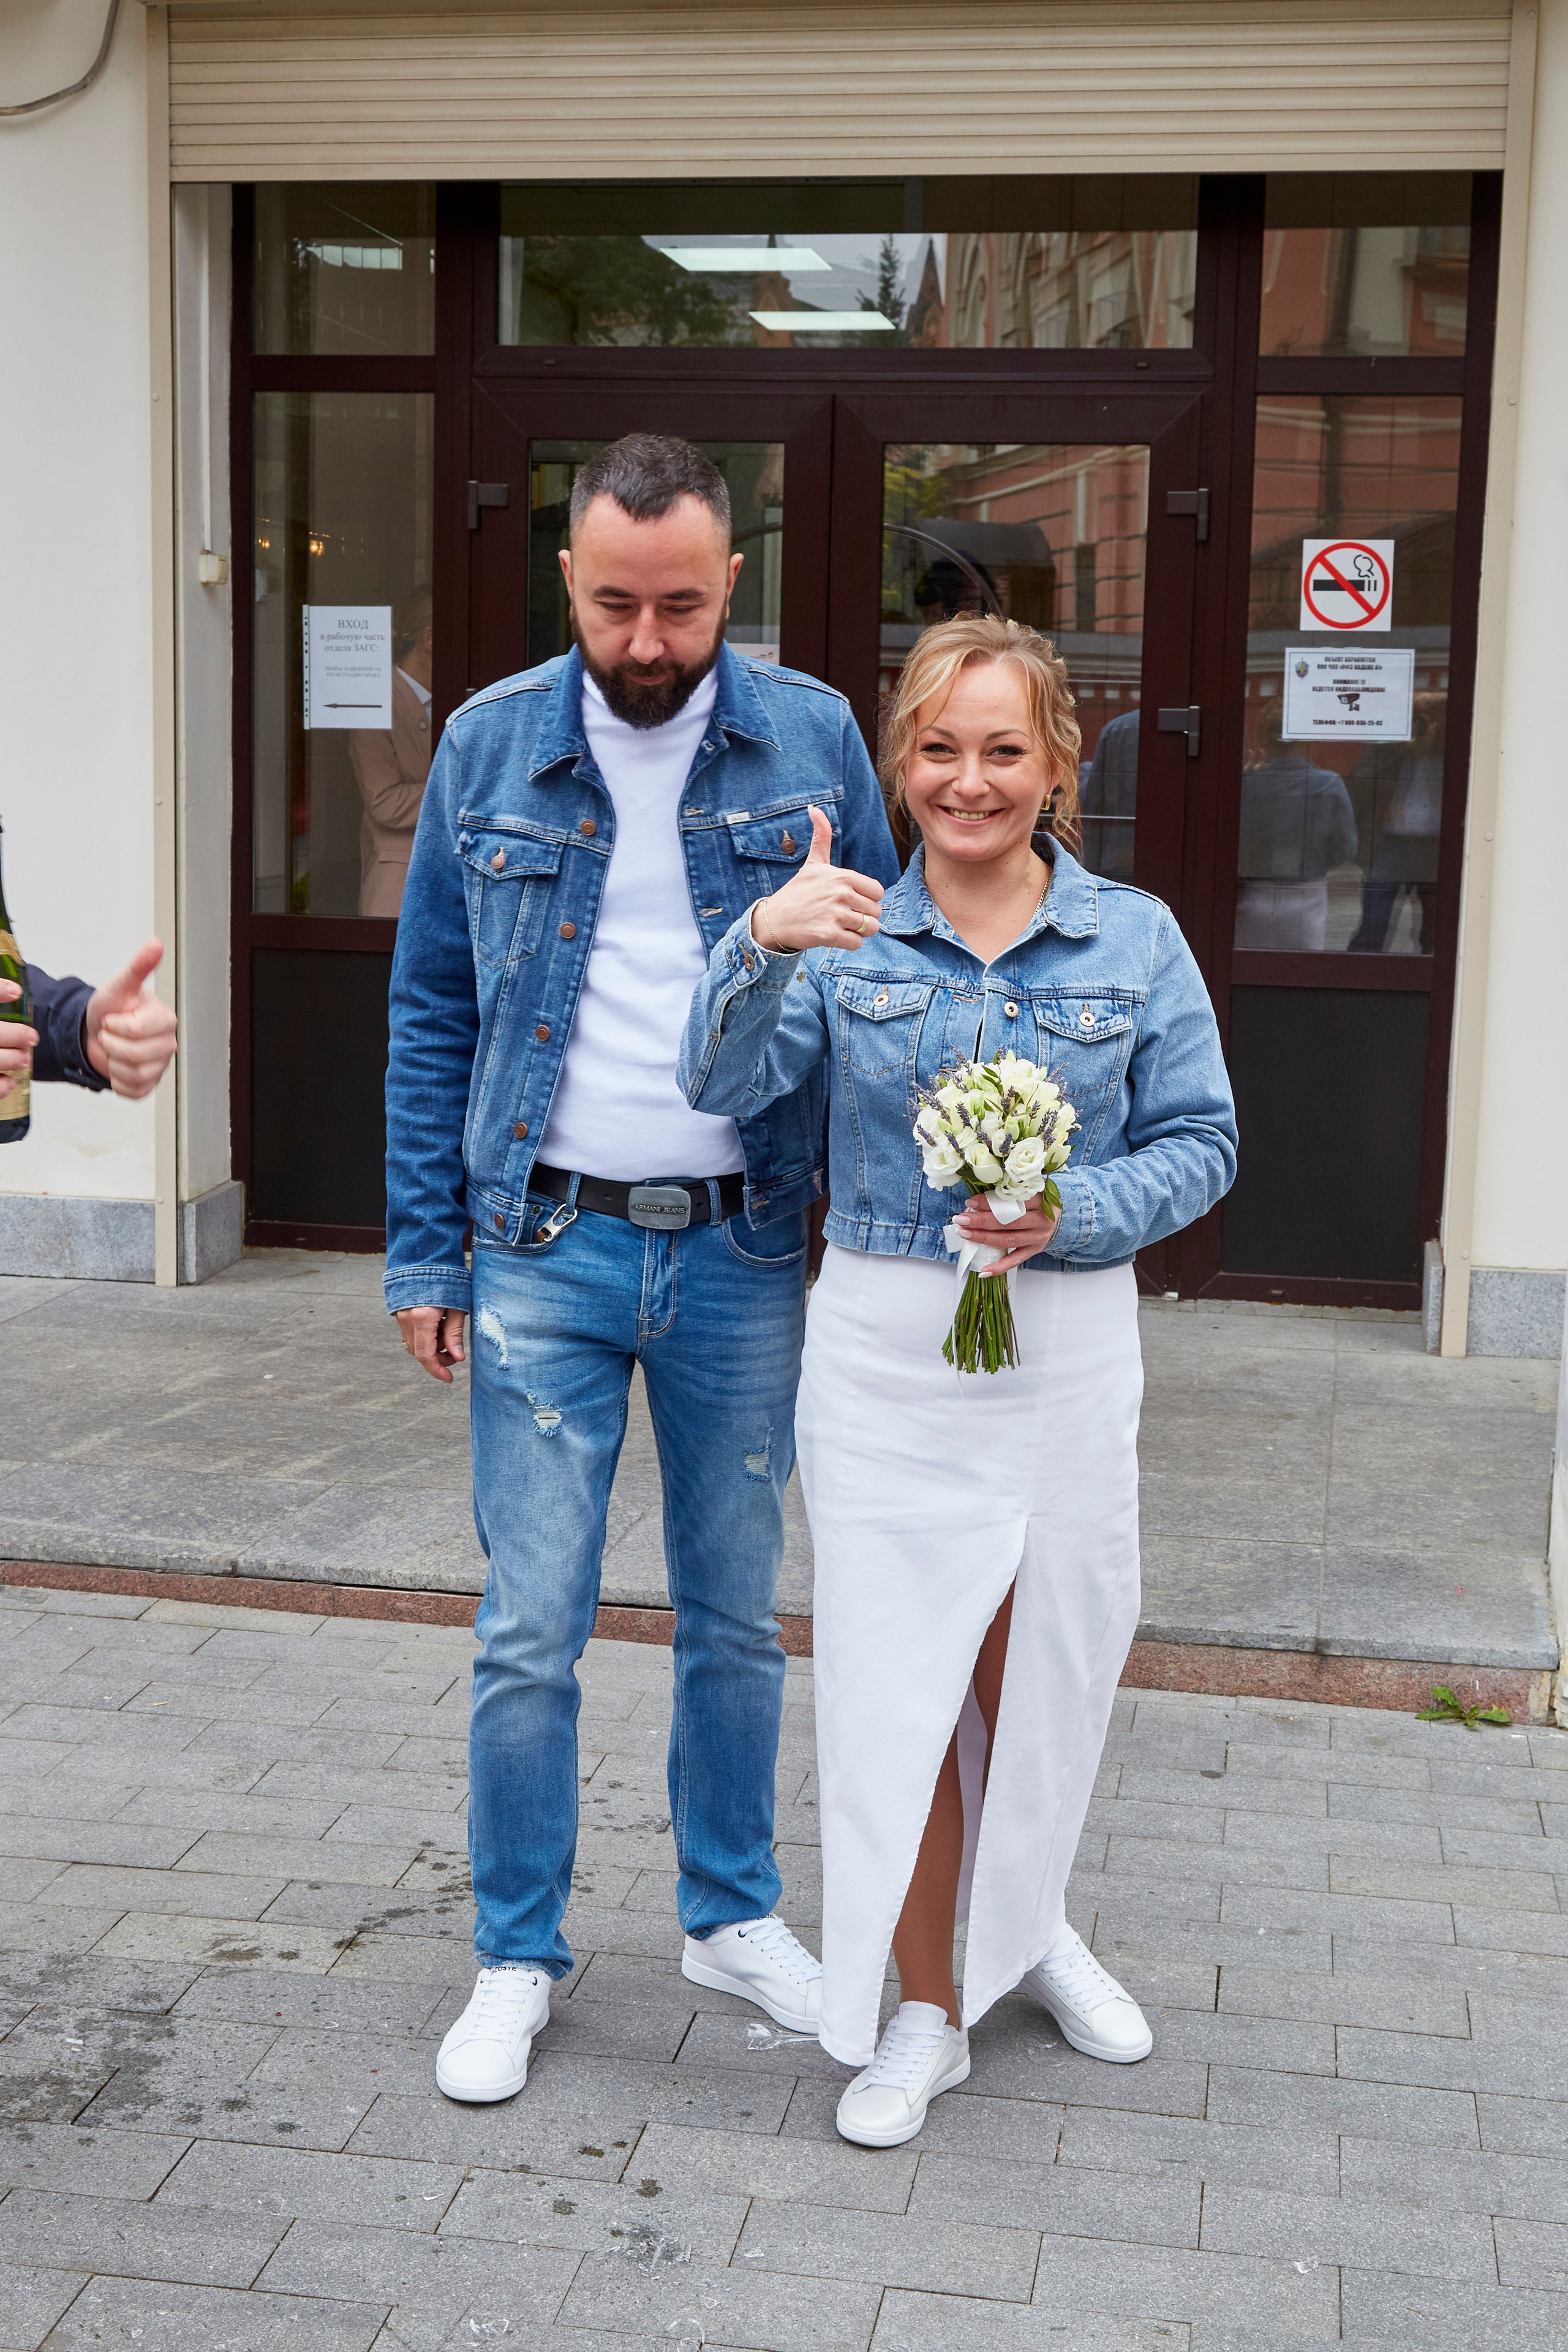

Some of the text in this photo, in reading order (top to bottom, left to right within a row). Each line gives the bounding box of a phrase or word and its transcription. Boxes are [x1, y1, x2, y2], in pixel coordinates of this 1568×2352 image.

[338, 619, 369, 630] ВХОД
[327, 632, 361, 642] рабочую
[353, 643, 379, 652] ЗАГС:
[634, 1204, 661, 1213] ARMANI
